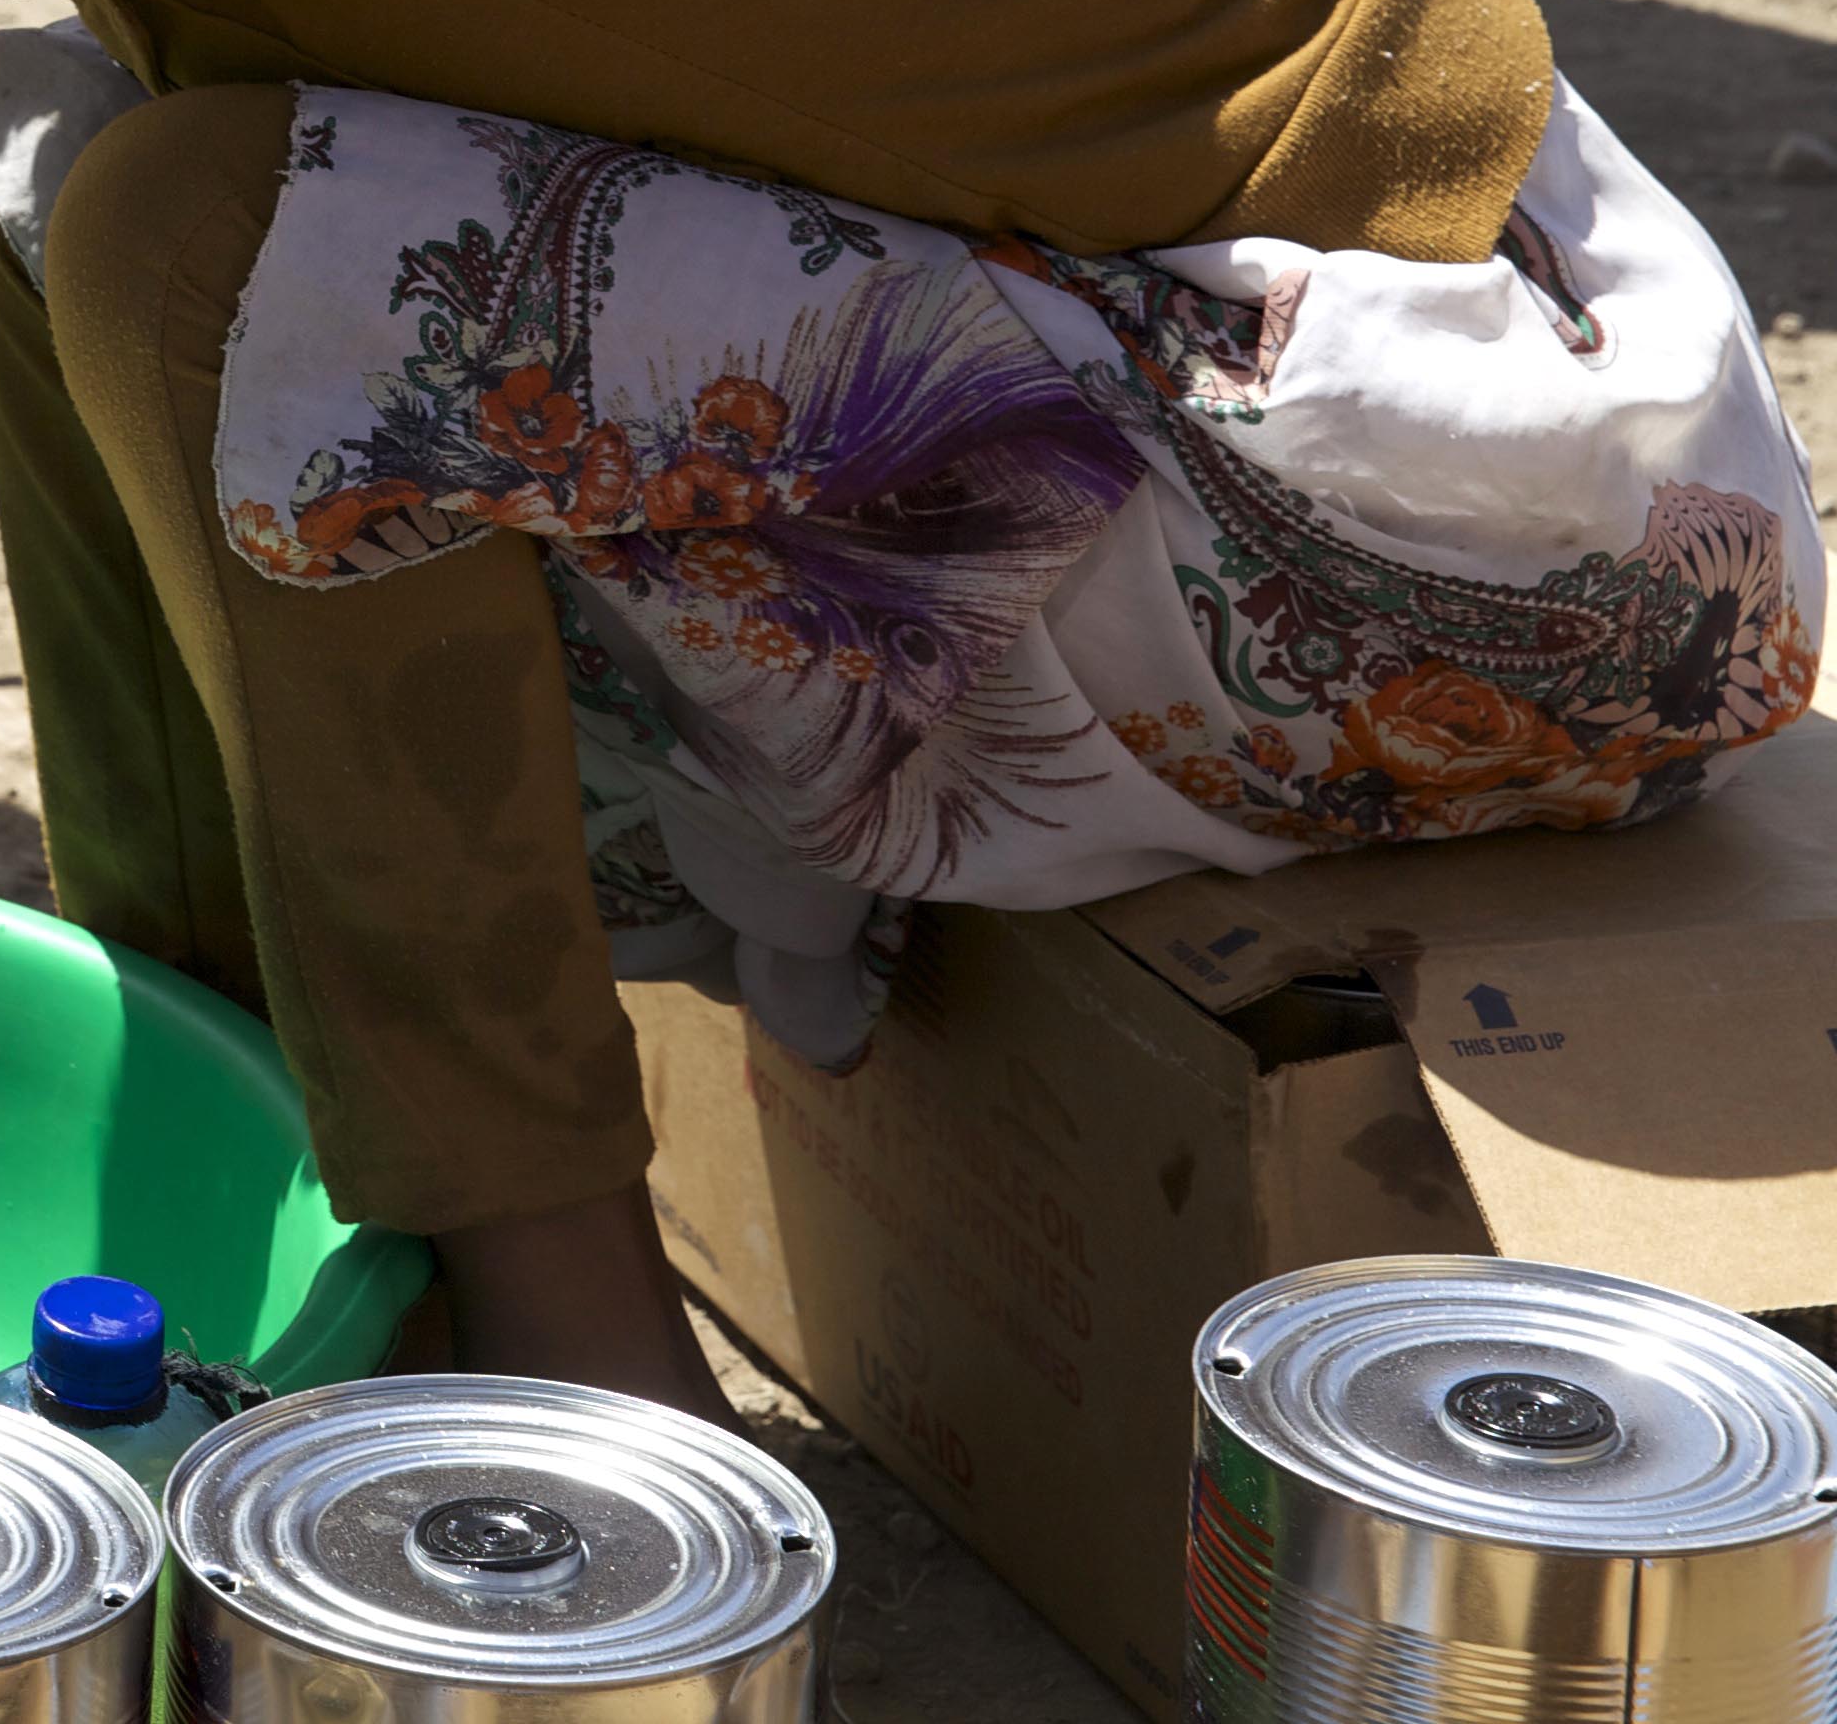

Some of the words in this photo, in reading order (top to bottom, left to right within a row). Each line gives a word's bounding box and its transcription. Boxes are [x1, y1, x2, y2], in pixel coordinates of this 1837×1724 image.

[1449, 1037, 1496, 1057] THIS
[1496, 1034, 1538, 1054] END
[1538, 1031, 1566, 1050] UP
[1039, 1191, 1096, 1281] OIL
[855, 1337, 974, 1489] USAID
